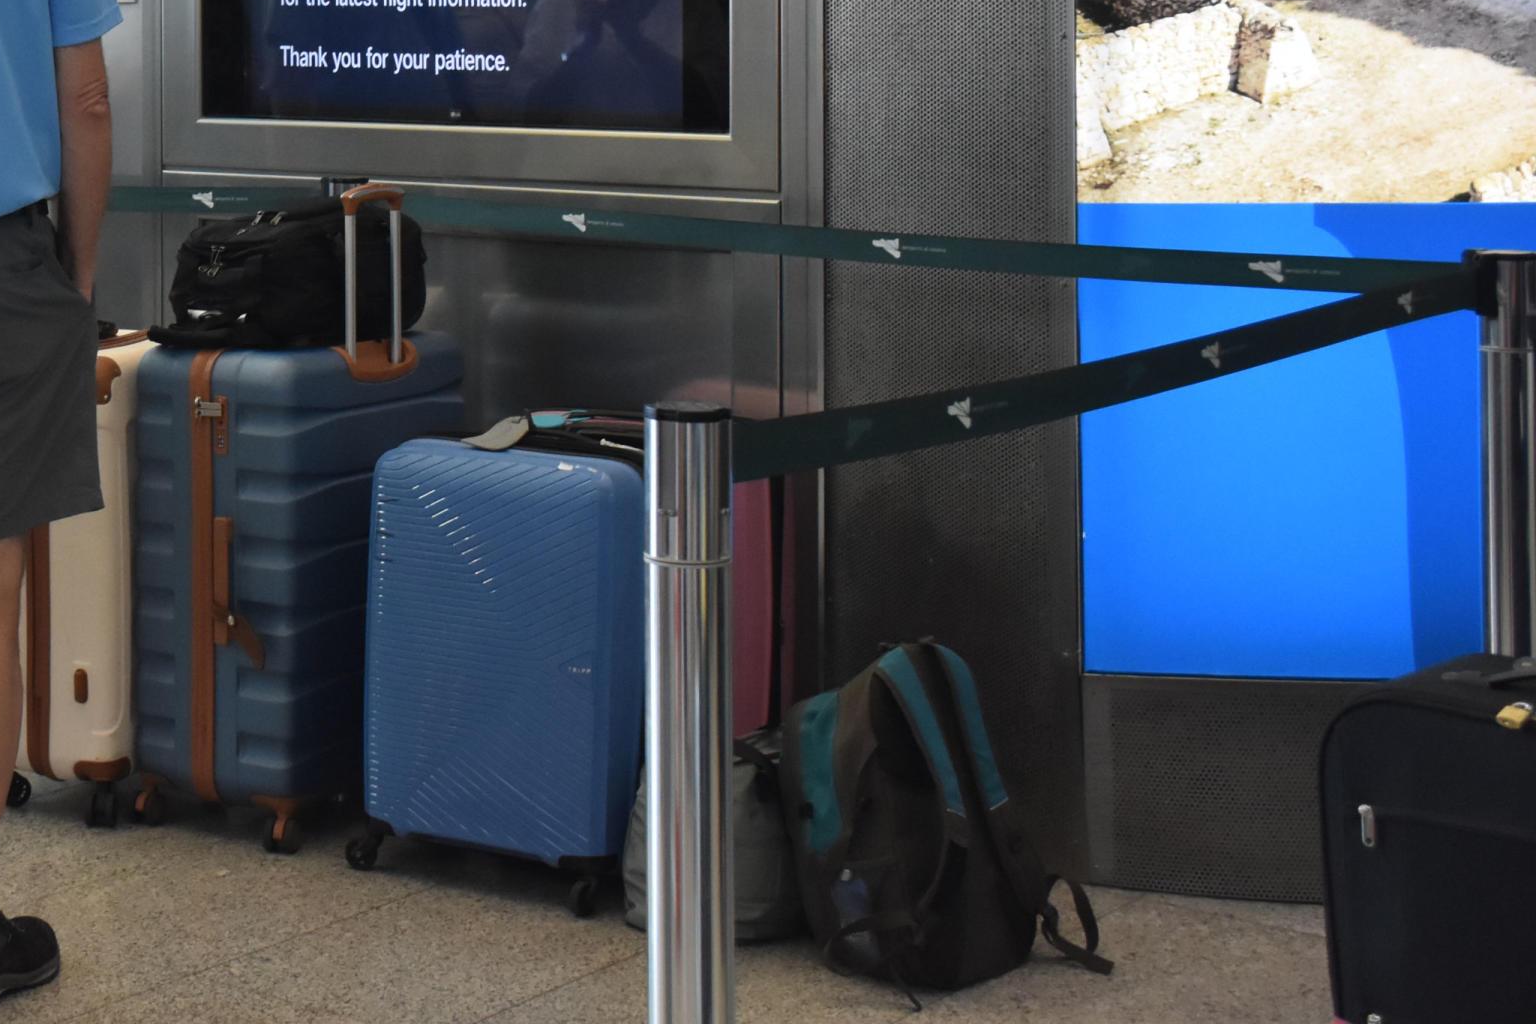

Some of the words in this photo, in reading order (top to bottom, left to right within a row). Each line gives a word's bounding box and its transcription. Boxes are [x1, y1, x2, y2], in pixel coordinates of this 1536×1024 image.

[280, 45, 327, 68] Thank
[332, 49, 361, 71] you
[366, 46, 389, 69] for
[394, 50, 427, 72] your
[435, 47, 510, 75] patience.
